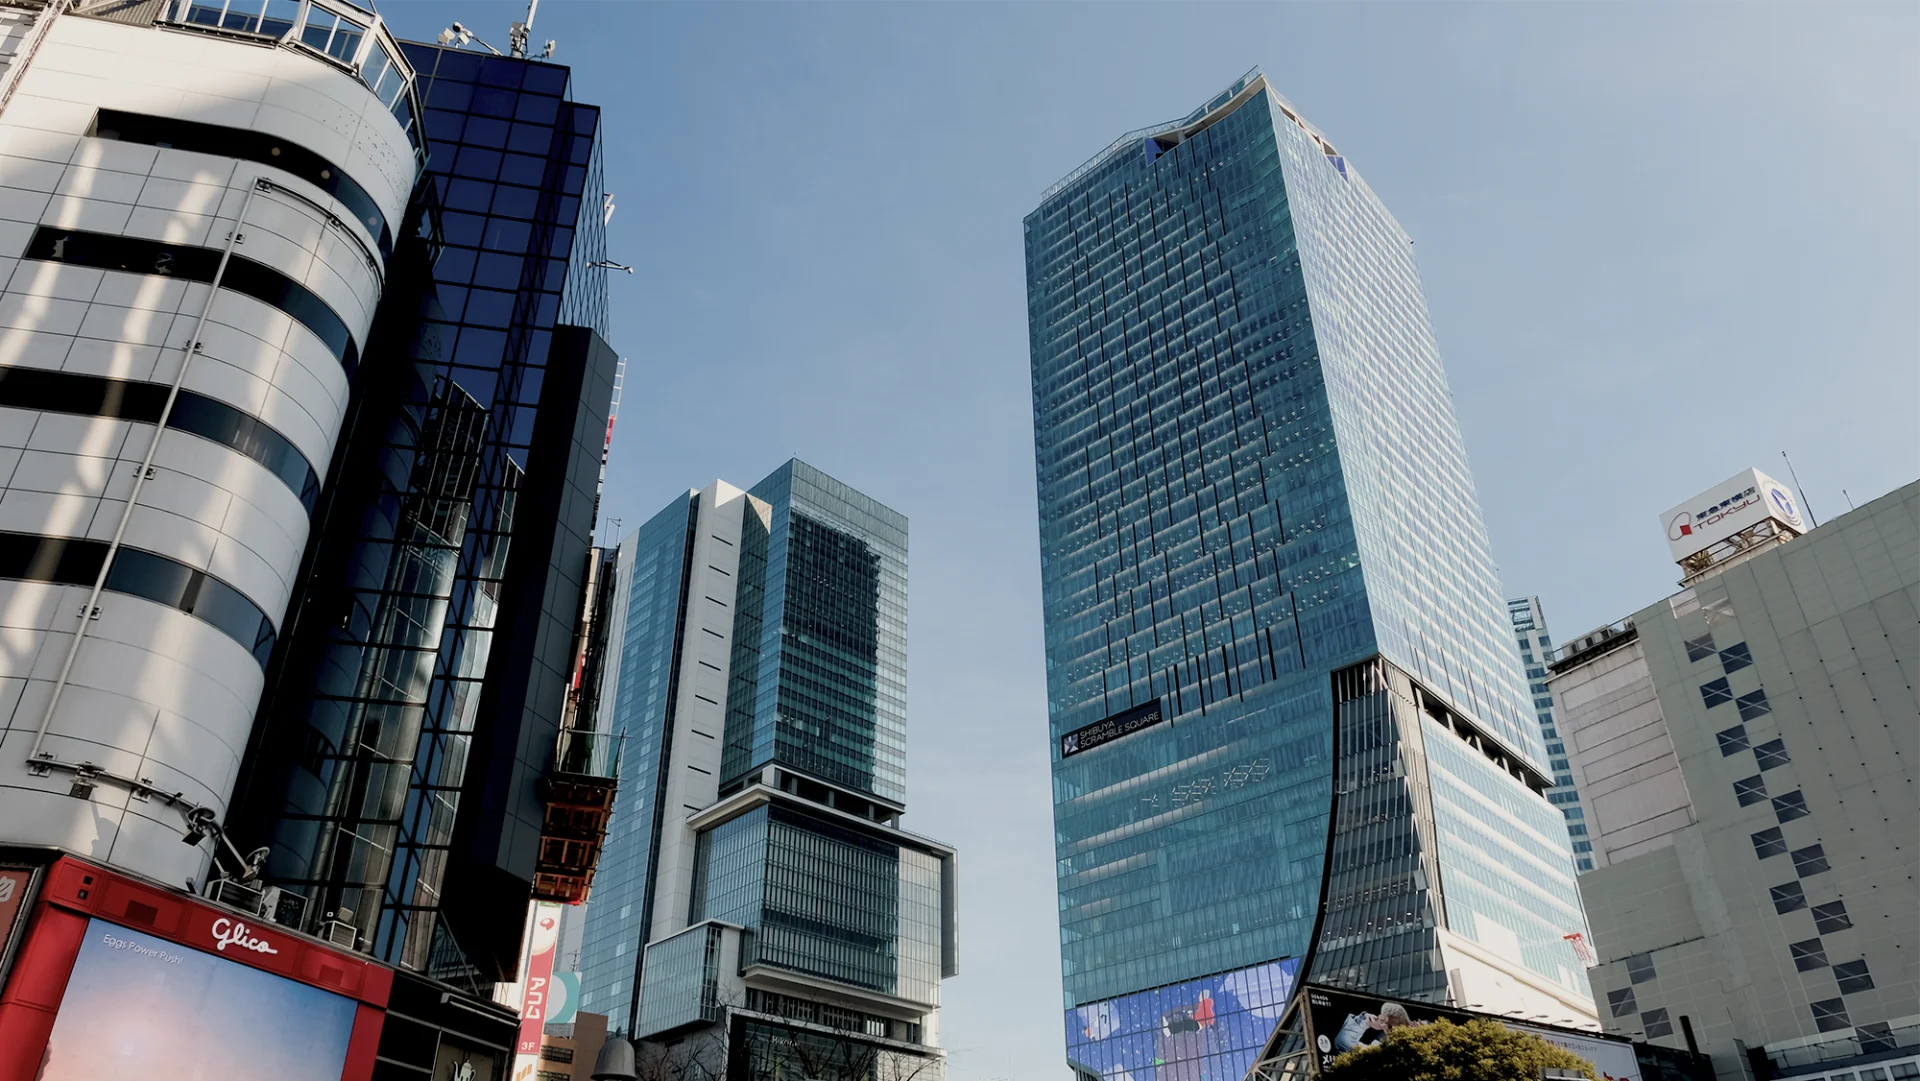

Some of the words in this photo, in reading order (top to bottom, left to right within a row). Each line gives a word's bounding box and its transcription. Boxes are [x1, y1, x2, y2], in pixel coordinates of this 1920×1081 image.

[1693, 494, 1761, 529] TOKYU
[1696, 486, 1756, 521] 東急東横店
[1080, 720, 1115, 739] SHIBUYA
[1080, 725, 1123, 748] SCRAMBLE
[1124, 711, 1160, 732] SQUARE
[103, 933, 127, 949] Eggs
[128, 941, 159, 957] Power
[159, 950, 185, 966] Push!
[212, 917, 278, 954] Glico
[525, 977, 546, 1019] アコム
[521, 1042, 535, 1051] 3F
